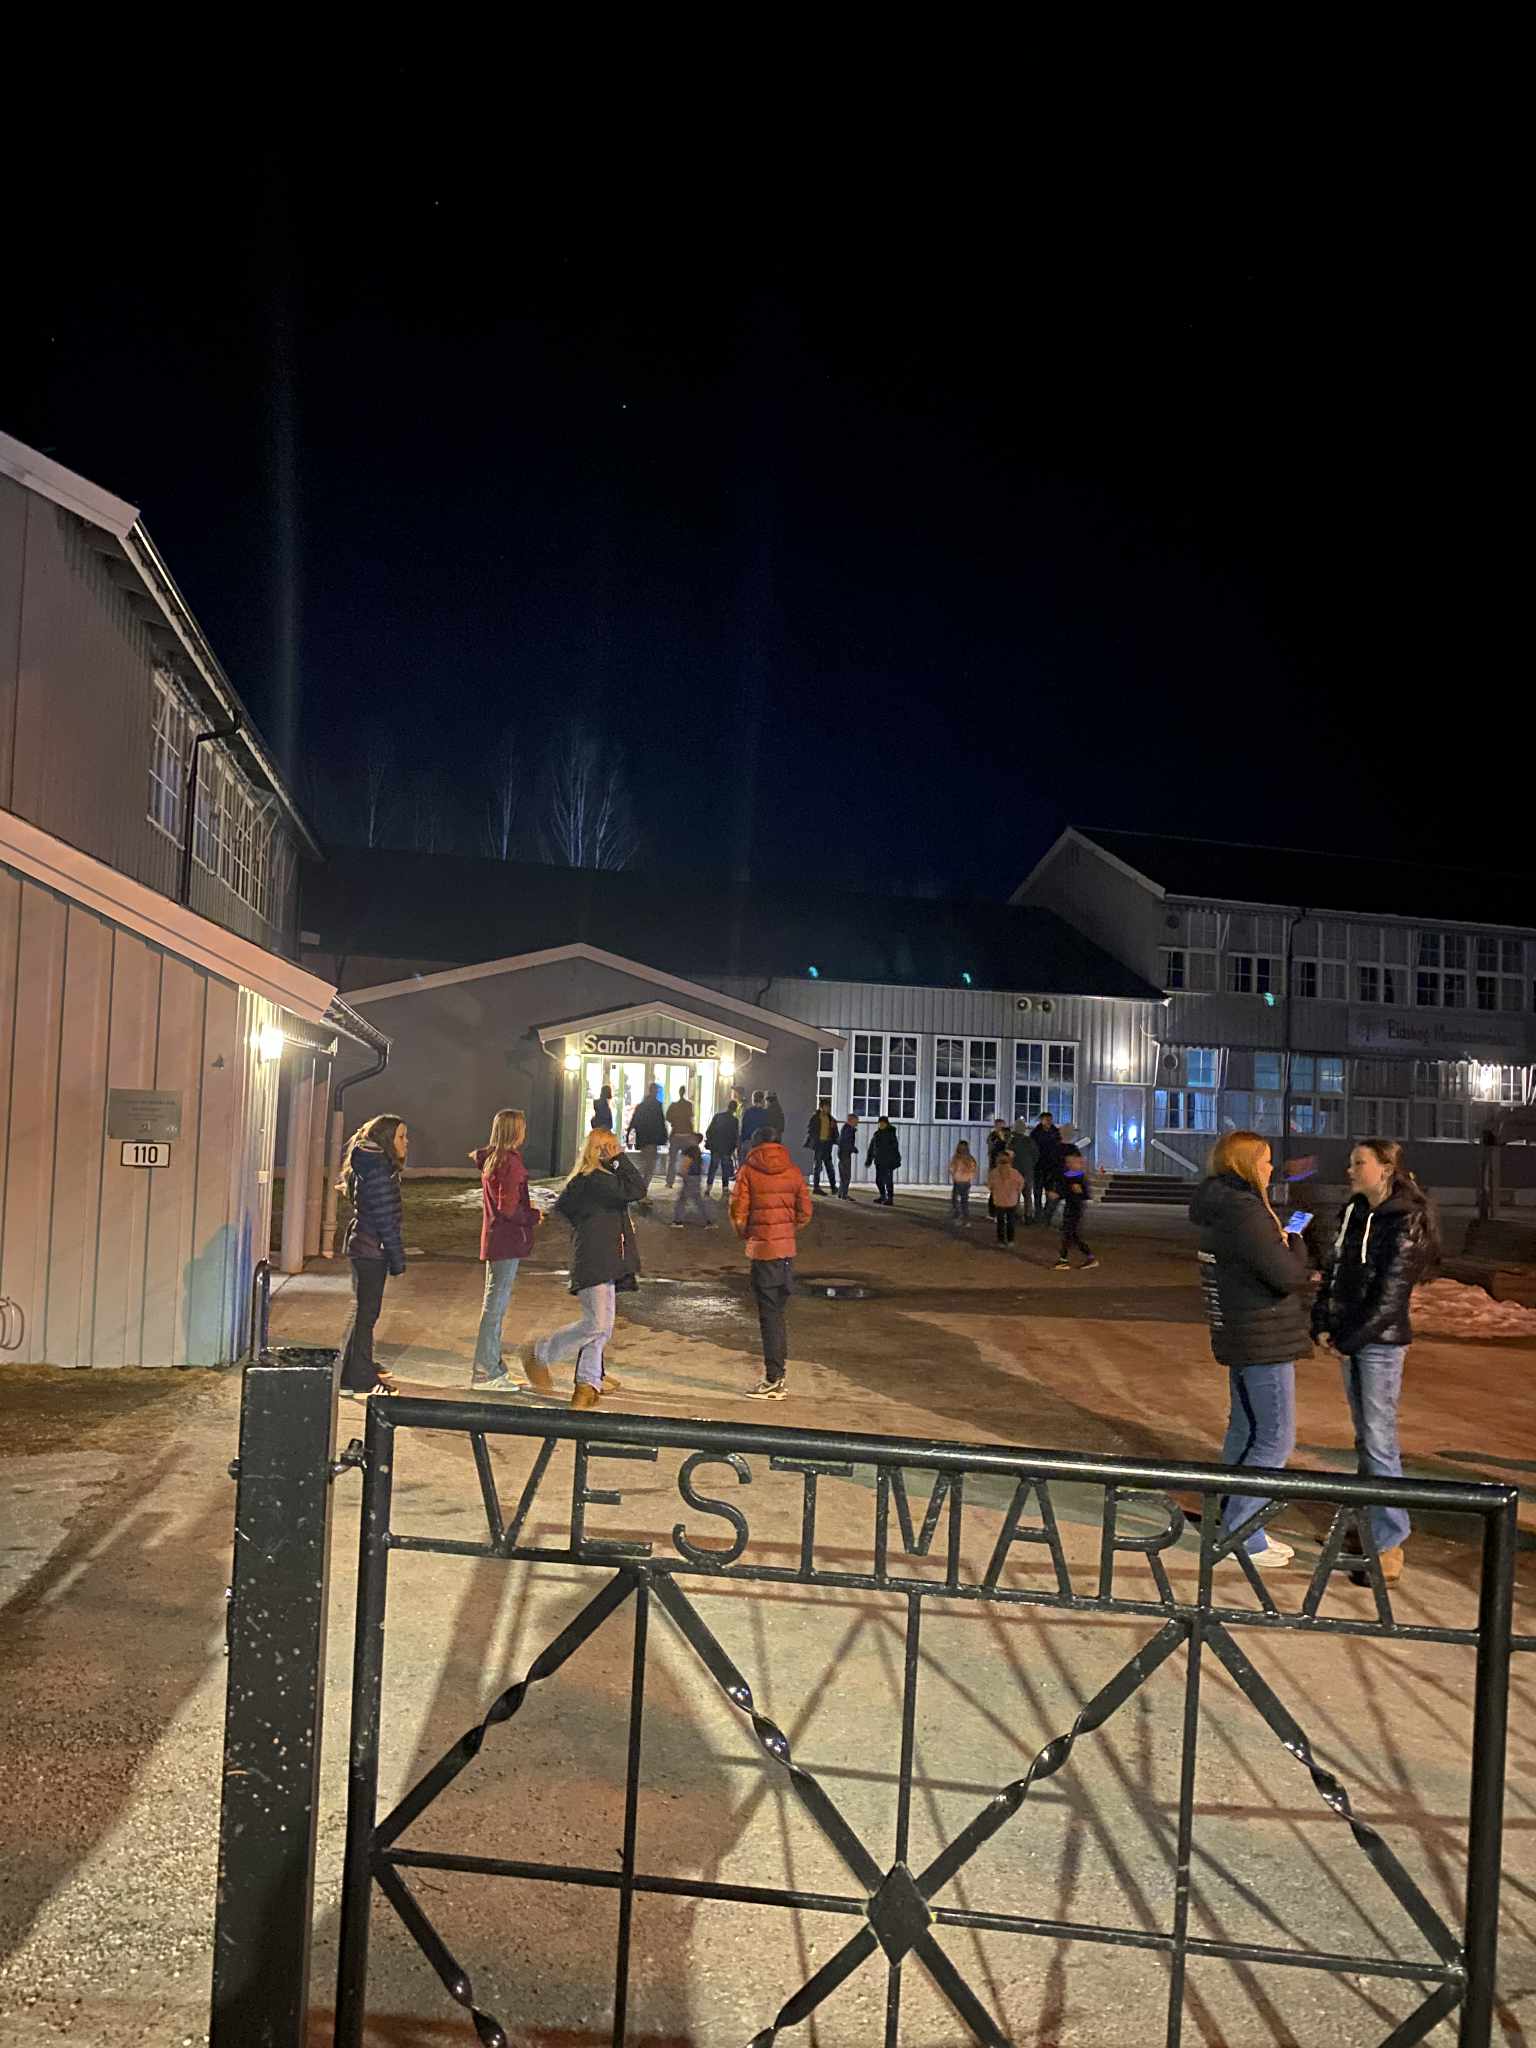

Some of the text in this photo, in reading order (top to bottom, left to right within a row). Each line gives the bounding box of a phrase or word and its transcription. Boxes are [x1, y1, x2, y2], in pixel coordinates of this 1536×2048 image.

[584, 1034, 718, 1057] Samfunnshus
[133, 1145, 158, 1164] 110
[470, 1432, 1395, 1628] VESTMARKA
